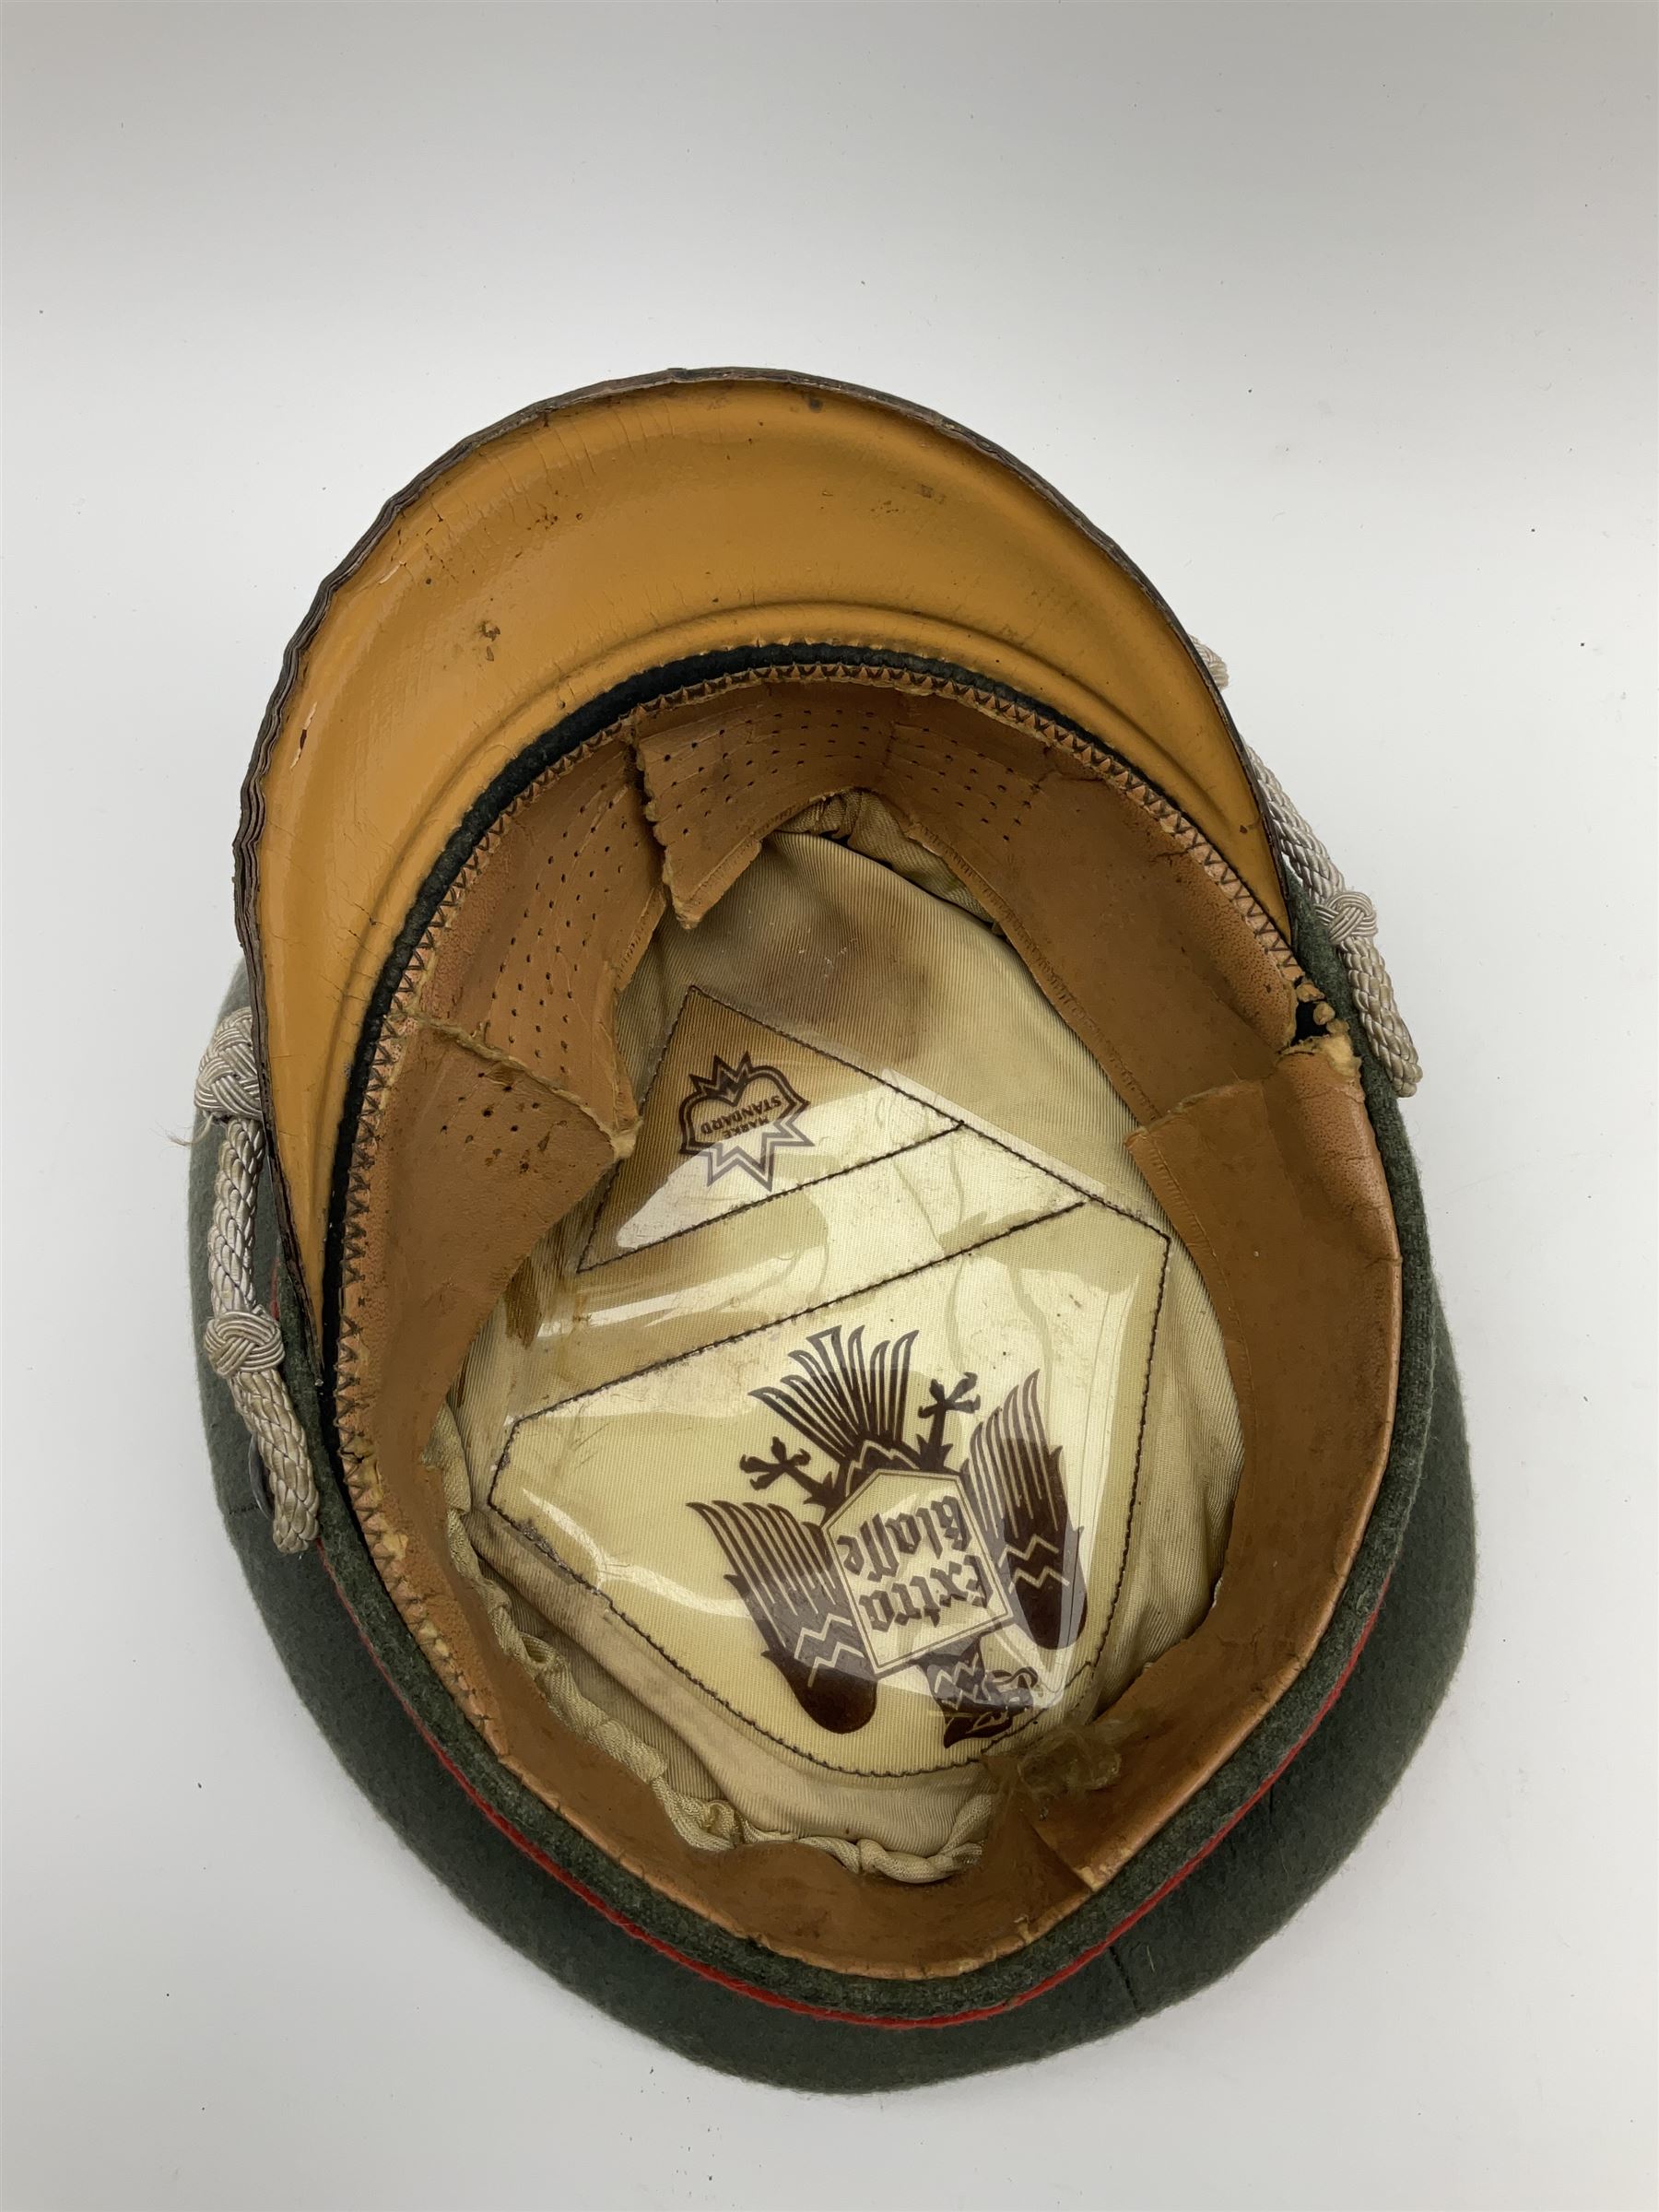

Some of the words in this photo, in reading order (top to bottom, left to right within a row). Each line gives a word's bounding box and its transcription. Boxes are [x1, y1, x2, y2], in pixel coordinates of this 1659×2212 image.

[700, 1096, 782, 1135] STANDARD
[722, 1116, 770, 1139] MARKE
[860, 1556, 993, 1631] Extra
